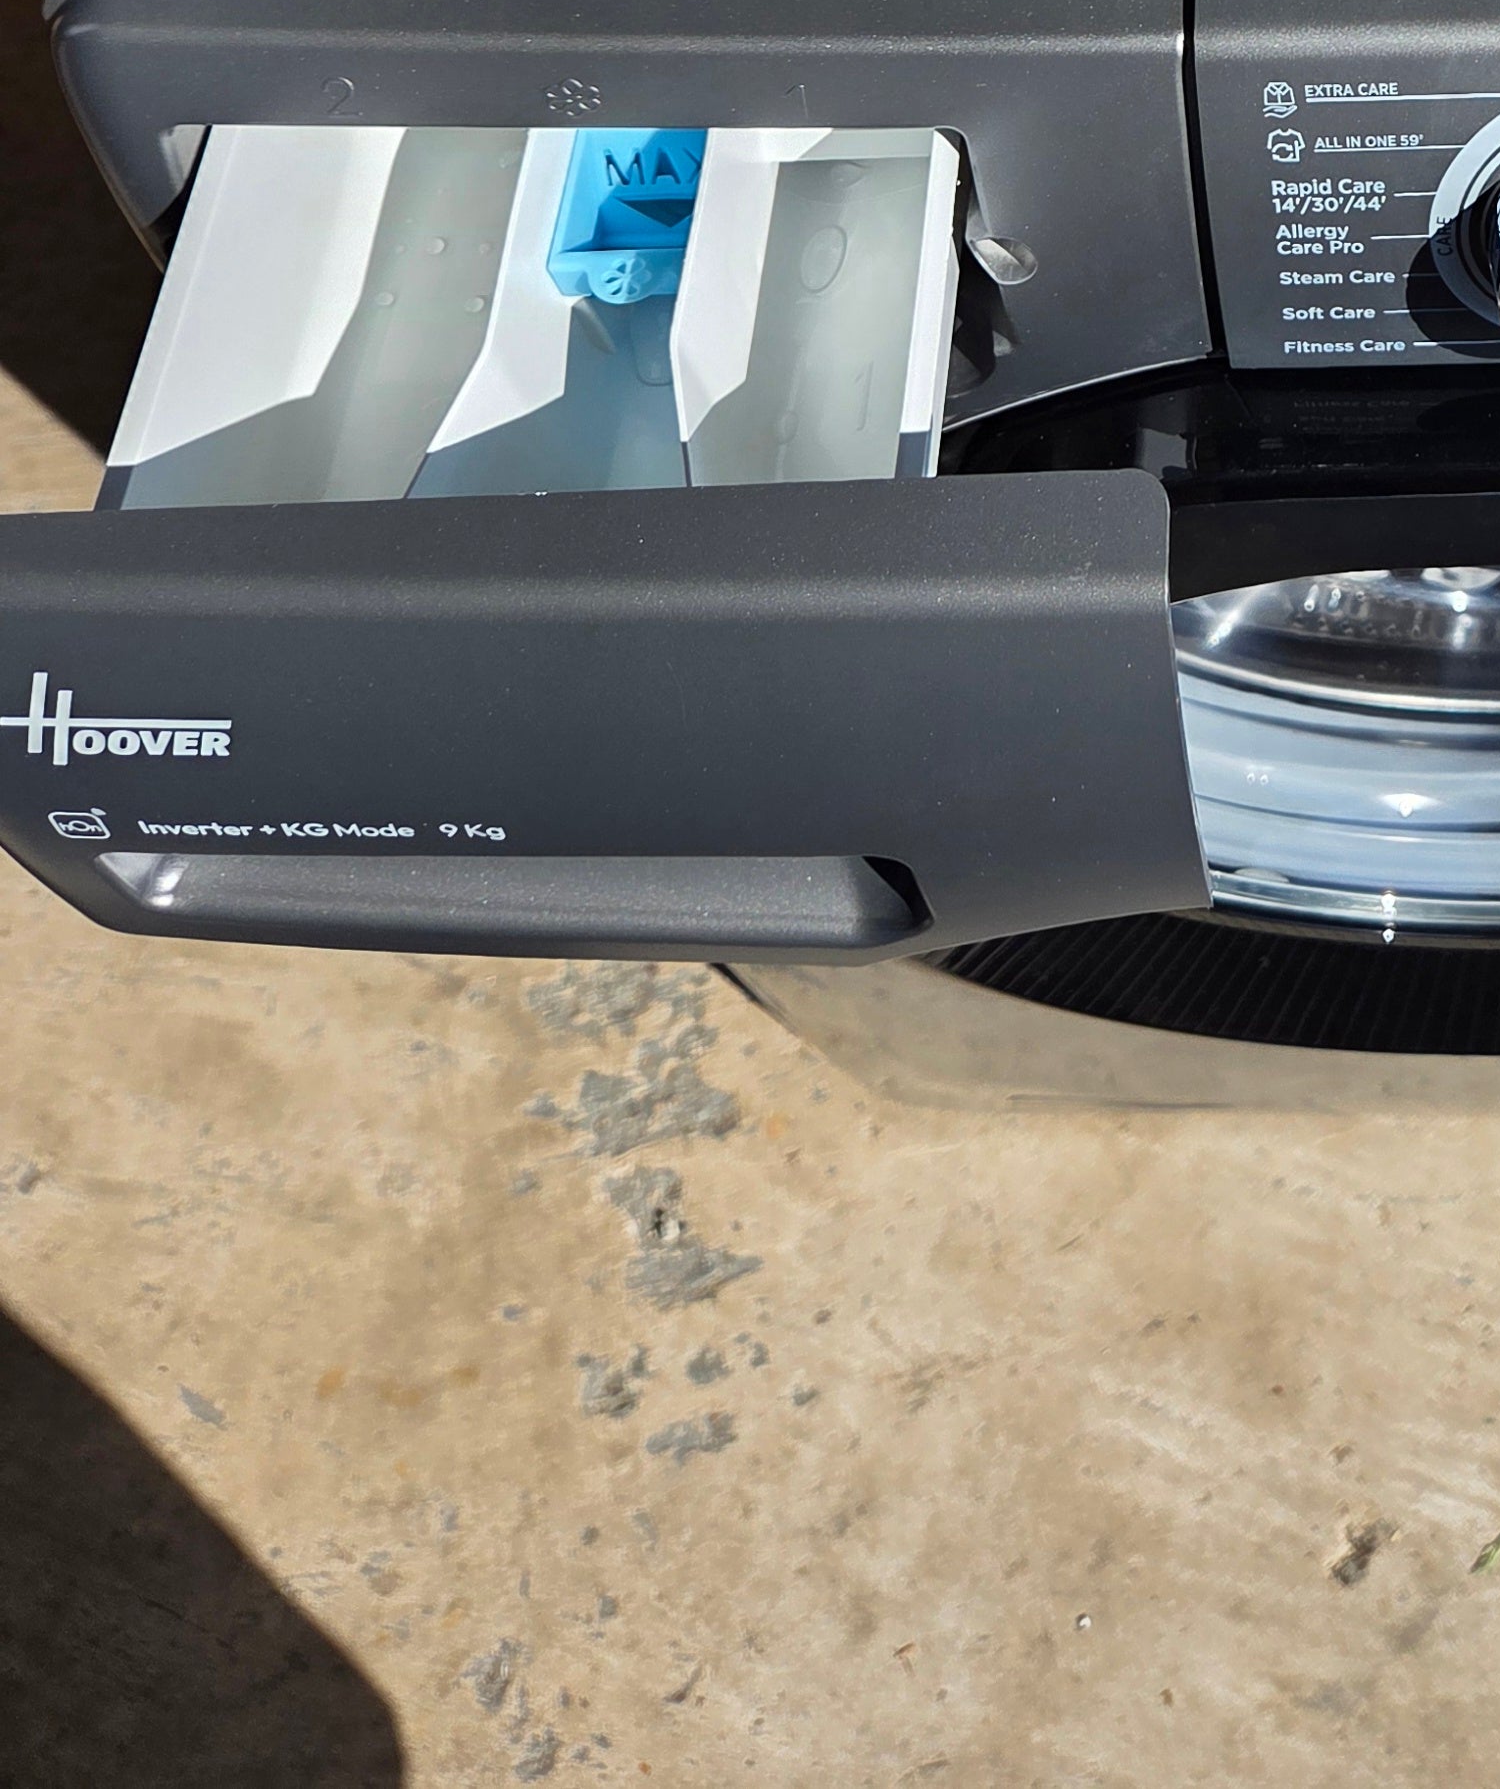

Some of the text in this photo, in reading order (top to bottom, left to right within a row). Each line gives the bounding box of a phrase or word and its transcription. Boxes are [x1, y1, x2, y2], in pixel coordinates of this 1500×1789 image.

[1305, 83, 1398, 97] EXTRA CARE
[1314, 137, 1342, 149] ALL
[1346, 136, 1361, 148] IN
[1365, 136, 1396, 148] ONE
[1271, 178, 1386, 197] Rapid Care
[1272, 196, 1386, 215] 14'/30'/44'
[1276, 224, 1348, 243] Allergy
[1437, 214, 1452, 256] CARE
[1277, 241, 1364, 255] Care Pro
[1280, 270, 1395, 285] Steam Care
[1282, 307, 1376, 320] Soft Care
[1284, 340, 1406, 353] Fitness Care
[0, 671, 232, 766] HOOVER
[138, 820, 506, 840] Inverter + KG Mode 9 Kg
